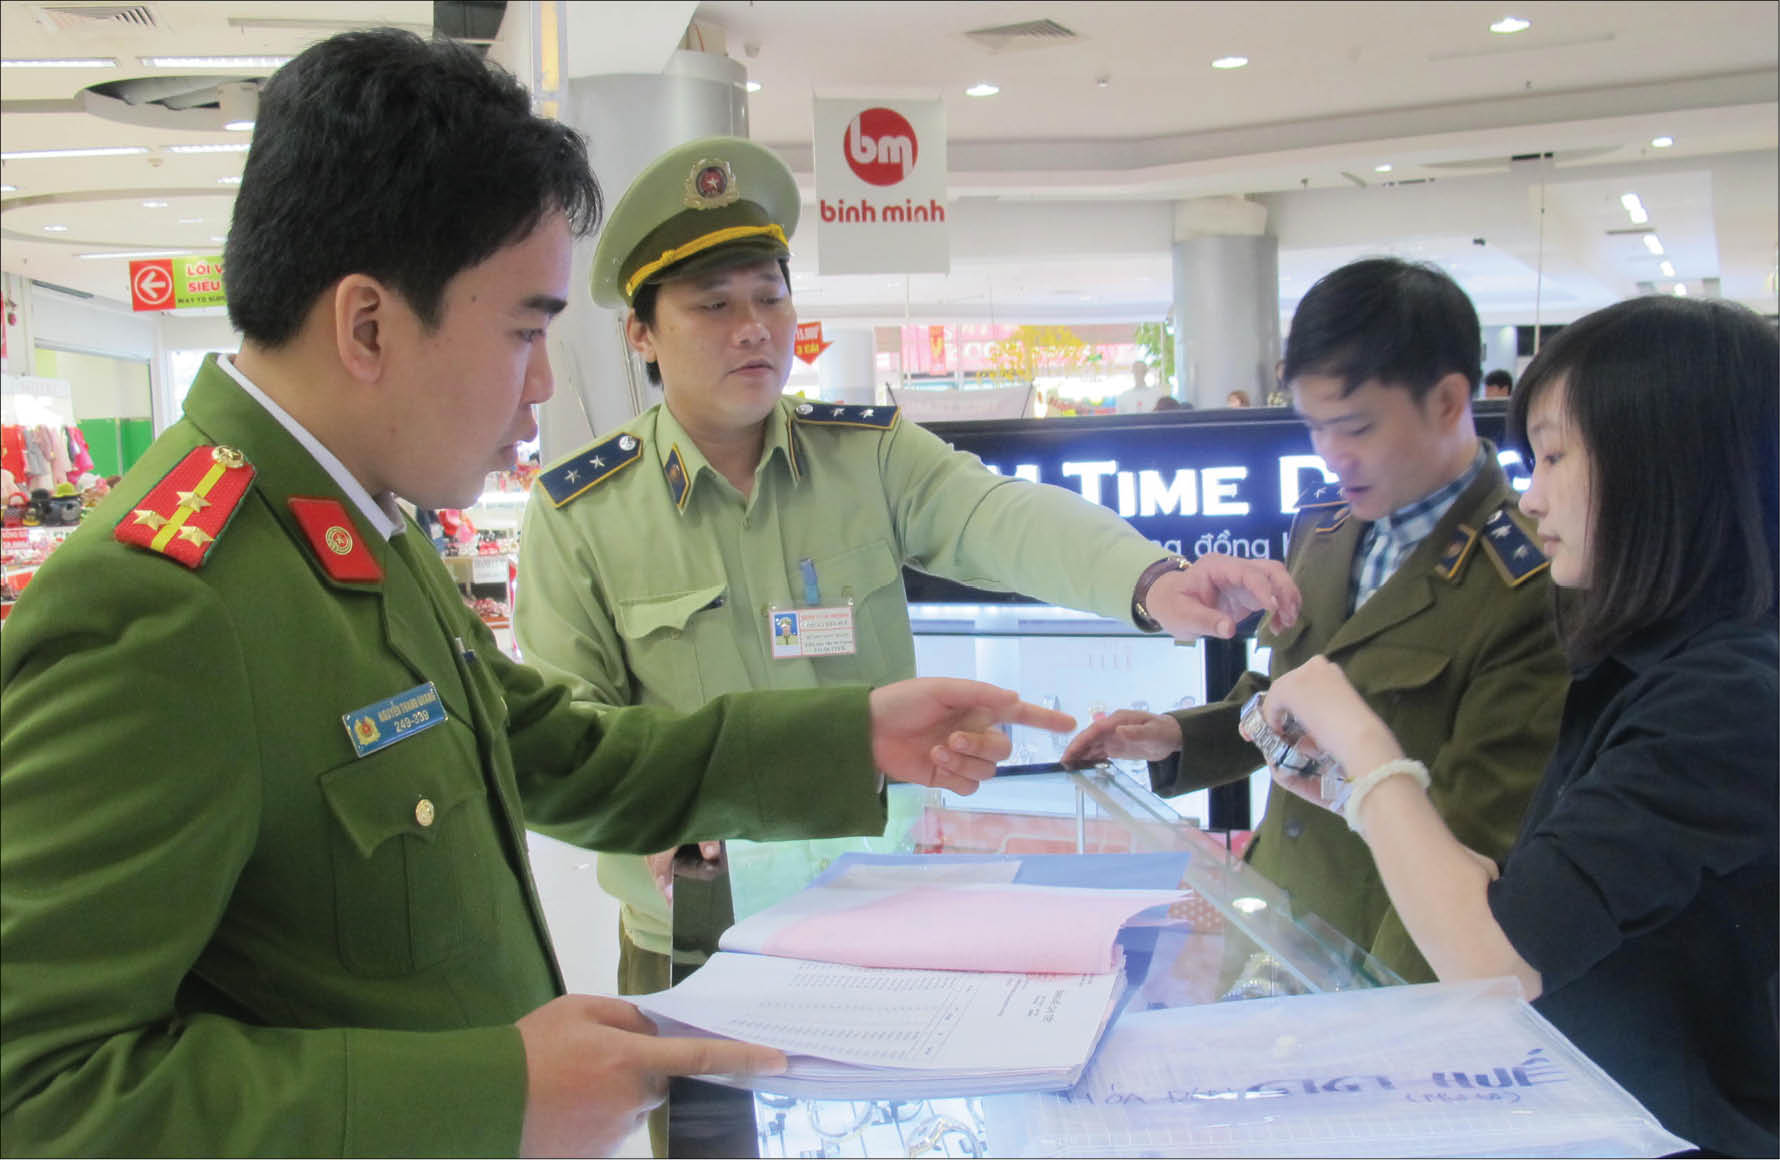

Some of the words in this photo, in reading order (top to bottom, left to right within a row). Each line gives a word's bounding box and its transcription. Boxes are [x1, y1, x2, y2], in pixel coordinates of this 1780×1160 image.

[850, 114, 913, 180] bm
[882, 198, 945, 223] minh
[1062, 459, 1250, 518] TIME
